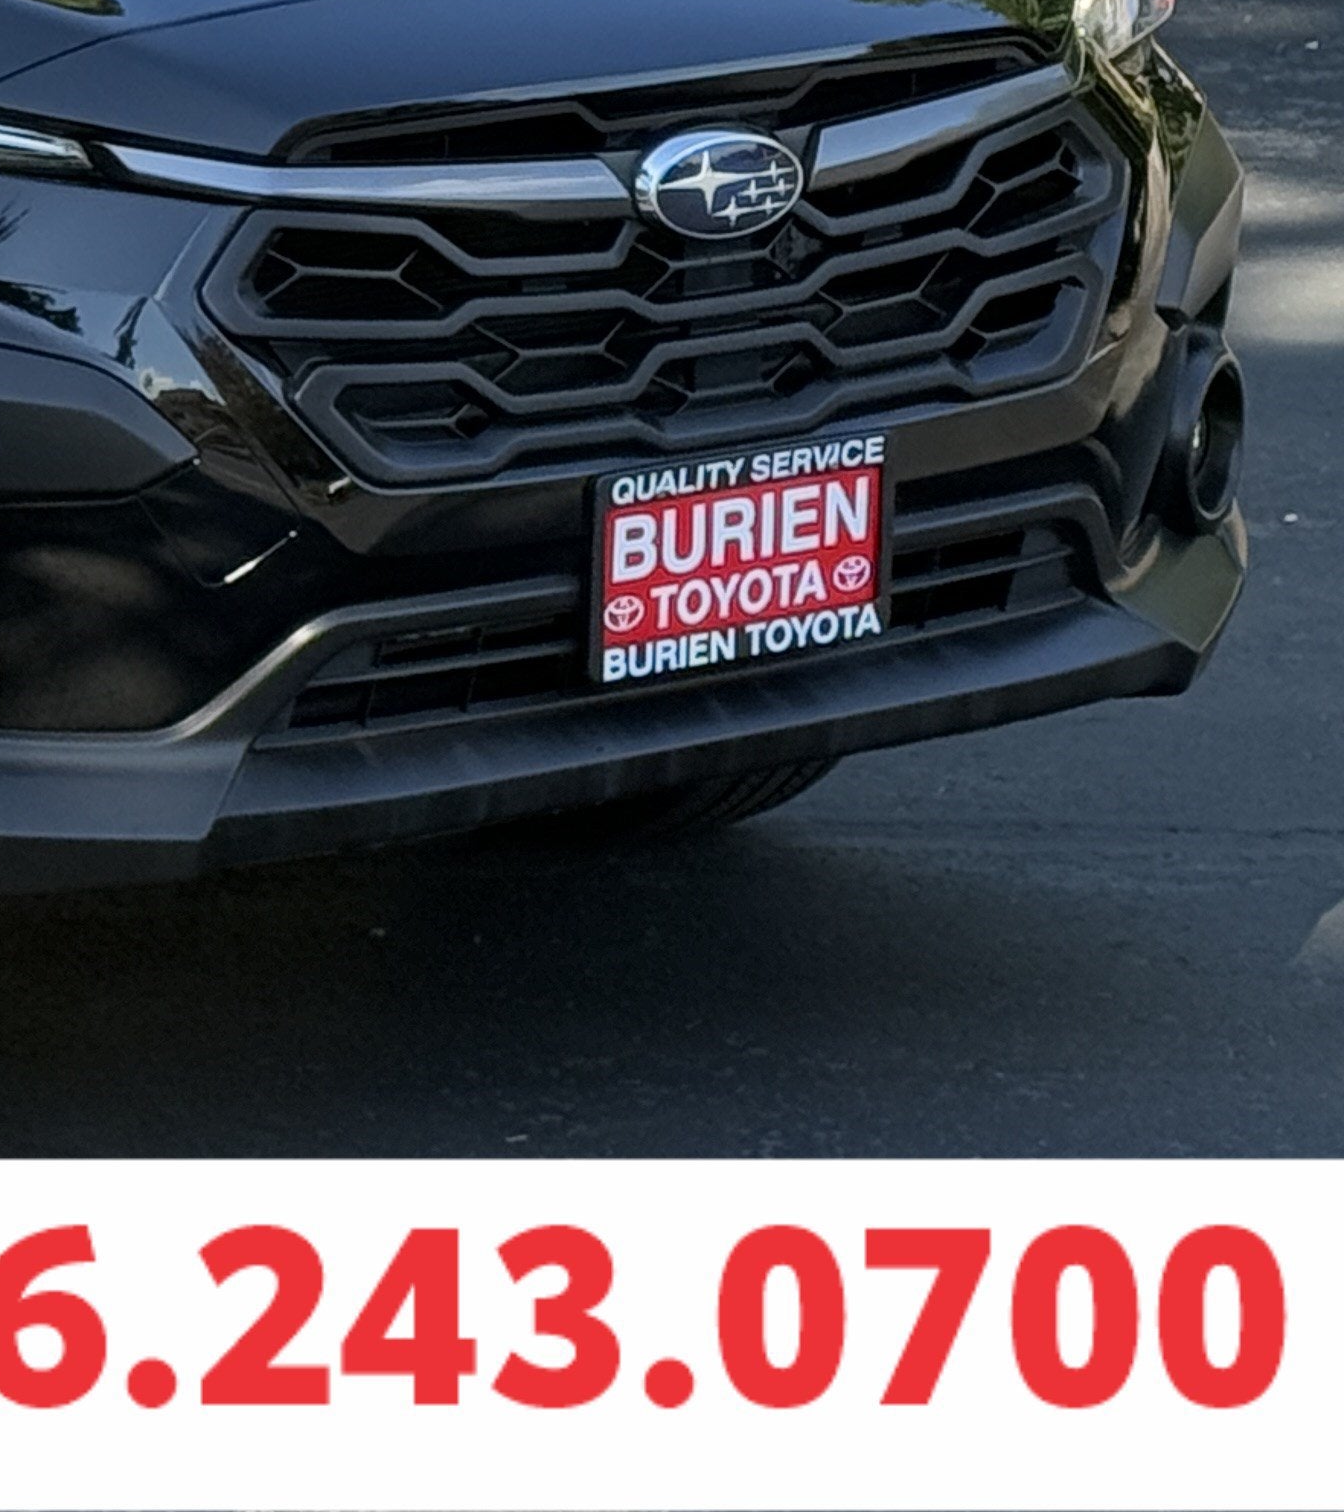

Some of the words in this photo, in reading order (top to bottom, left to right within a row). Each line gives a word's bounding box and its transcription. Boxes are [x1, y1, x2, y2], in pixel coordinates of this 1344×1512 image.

[612, 456, 745, 505] QUALITY
[750, 435, 885, 482] SERVICE
[611, 476, 869, 584] BURIEN
[650, 559, 828, 630] TOYOTA
[603, 627, 736, 683] BURIEN
[744, 602, 882, 656] TOYOTA
